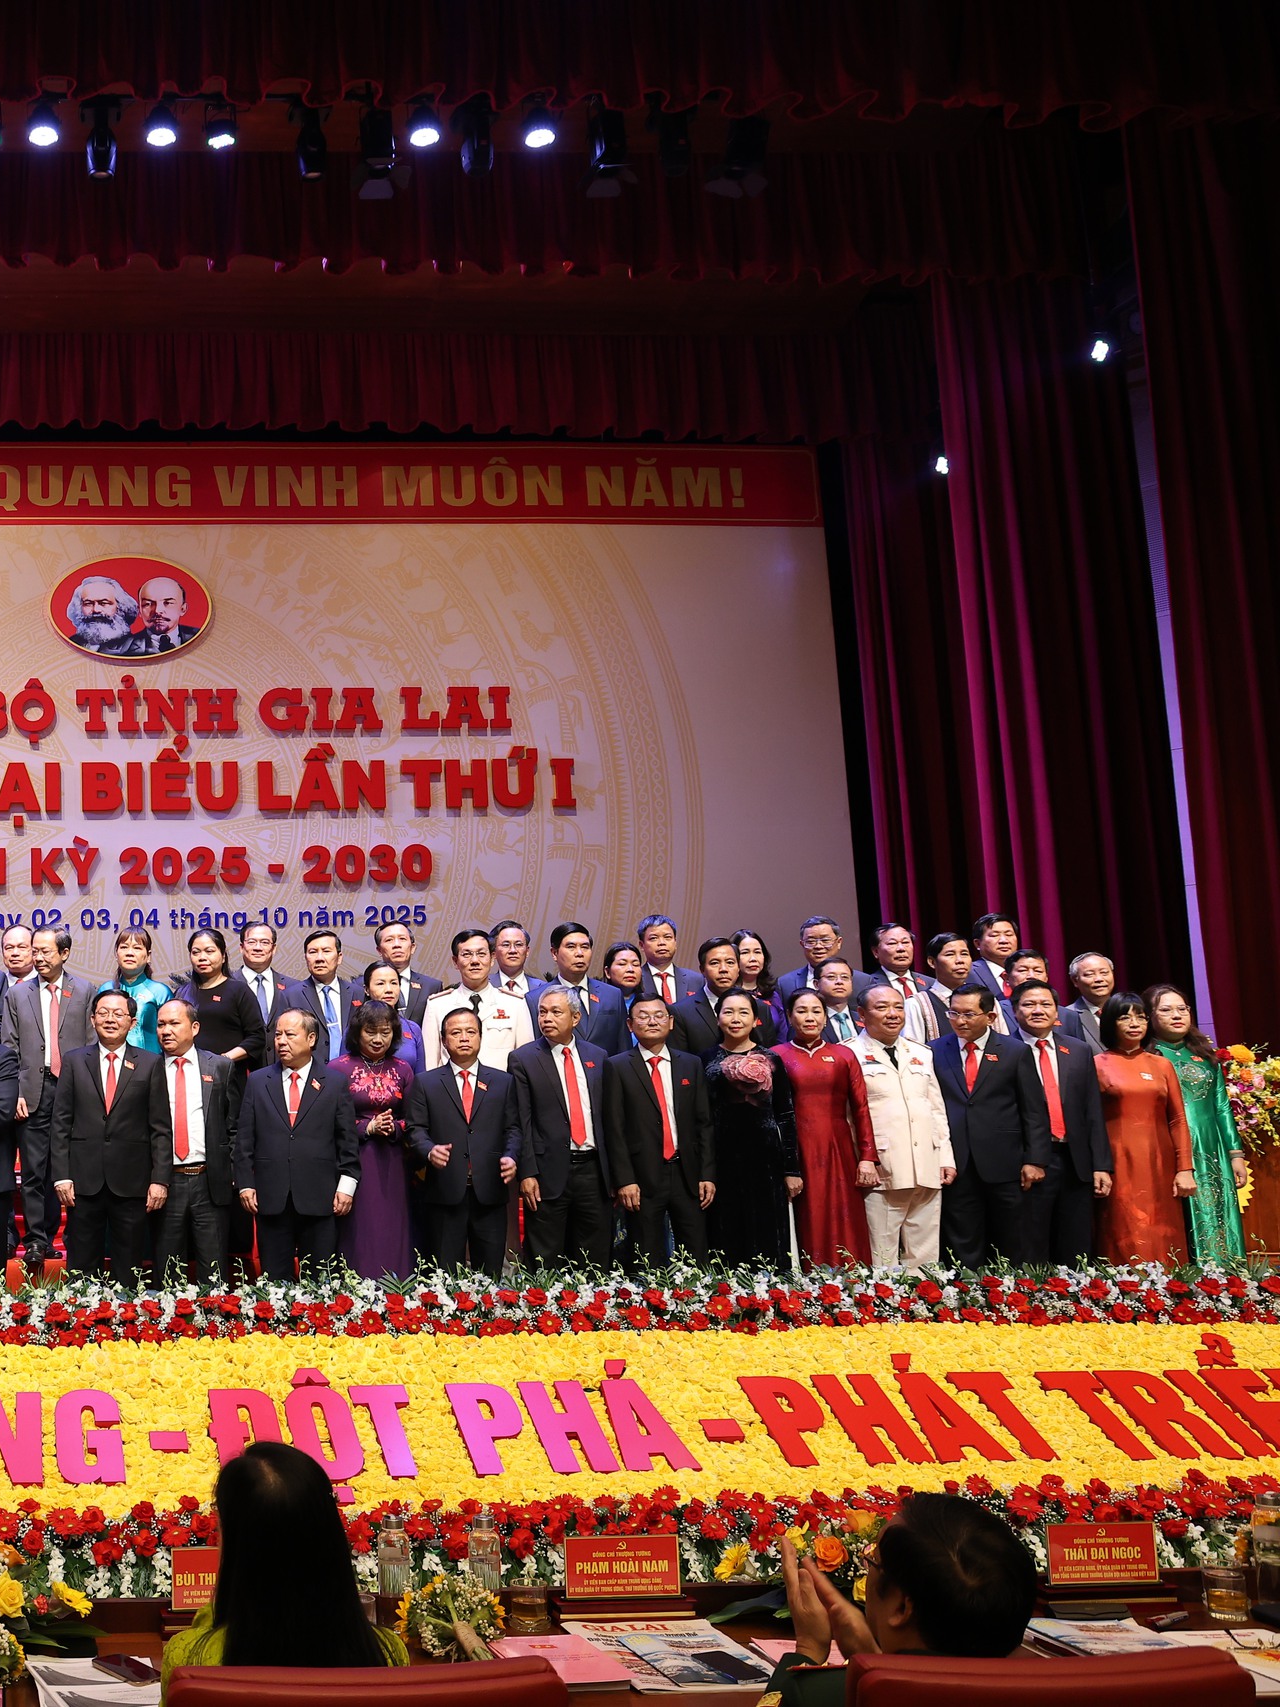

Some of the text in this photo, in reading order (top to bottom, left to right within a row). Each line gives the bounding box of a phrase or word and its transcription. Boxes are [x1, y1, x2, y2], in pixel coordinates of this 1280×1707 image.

[213, 466, 359, 507] VINH
[381, 456, 564, 507] MUÔN
[585, 457, 745, 508] NĂM!
[76, 674, 239, 733] TỈNH
[259, 687, 383, 733] GIA
[399, 686, 512, 730] LAI
[81, 734, 239, 813] BIỂU
[257, 742, 387, 812] LẦN
[400, 745, 538, 809] THỨ
[550, 758, 577, 807] I
[31, 835, 99, 886] KỲ
[119, 846, 251, 886] 2025
[302, 843, 433, 884] 2030
[80, 908, 120, 933] 03,
[129, 908, 160, 929] 04
[169, 906, 249, 933] tháng
[258, 906, 289, 929] 10
[298, 905, 354, 928] năm
[364, 904, 428, 926] 2025
[208, 1368, 418, 1505] ĐỘT
[445, 1359, 702, 1477] PHÁ
[737, 1353, 1060, 1468] PHÁT
[1034, 1333, 1280, 1461] TRIỂ
[576, 1558, 668, 1576] PHẠM HOÀI NAM
[1064, 1546, 1142, 1562] THÁI ĐẠI NGỌC
[176, 1571, 195, 1586] BÙI
[582, 1624, 627, 1632] GIA
